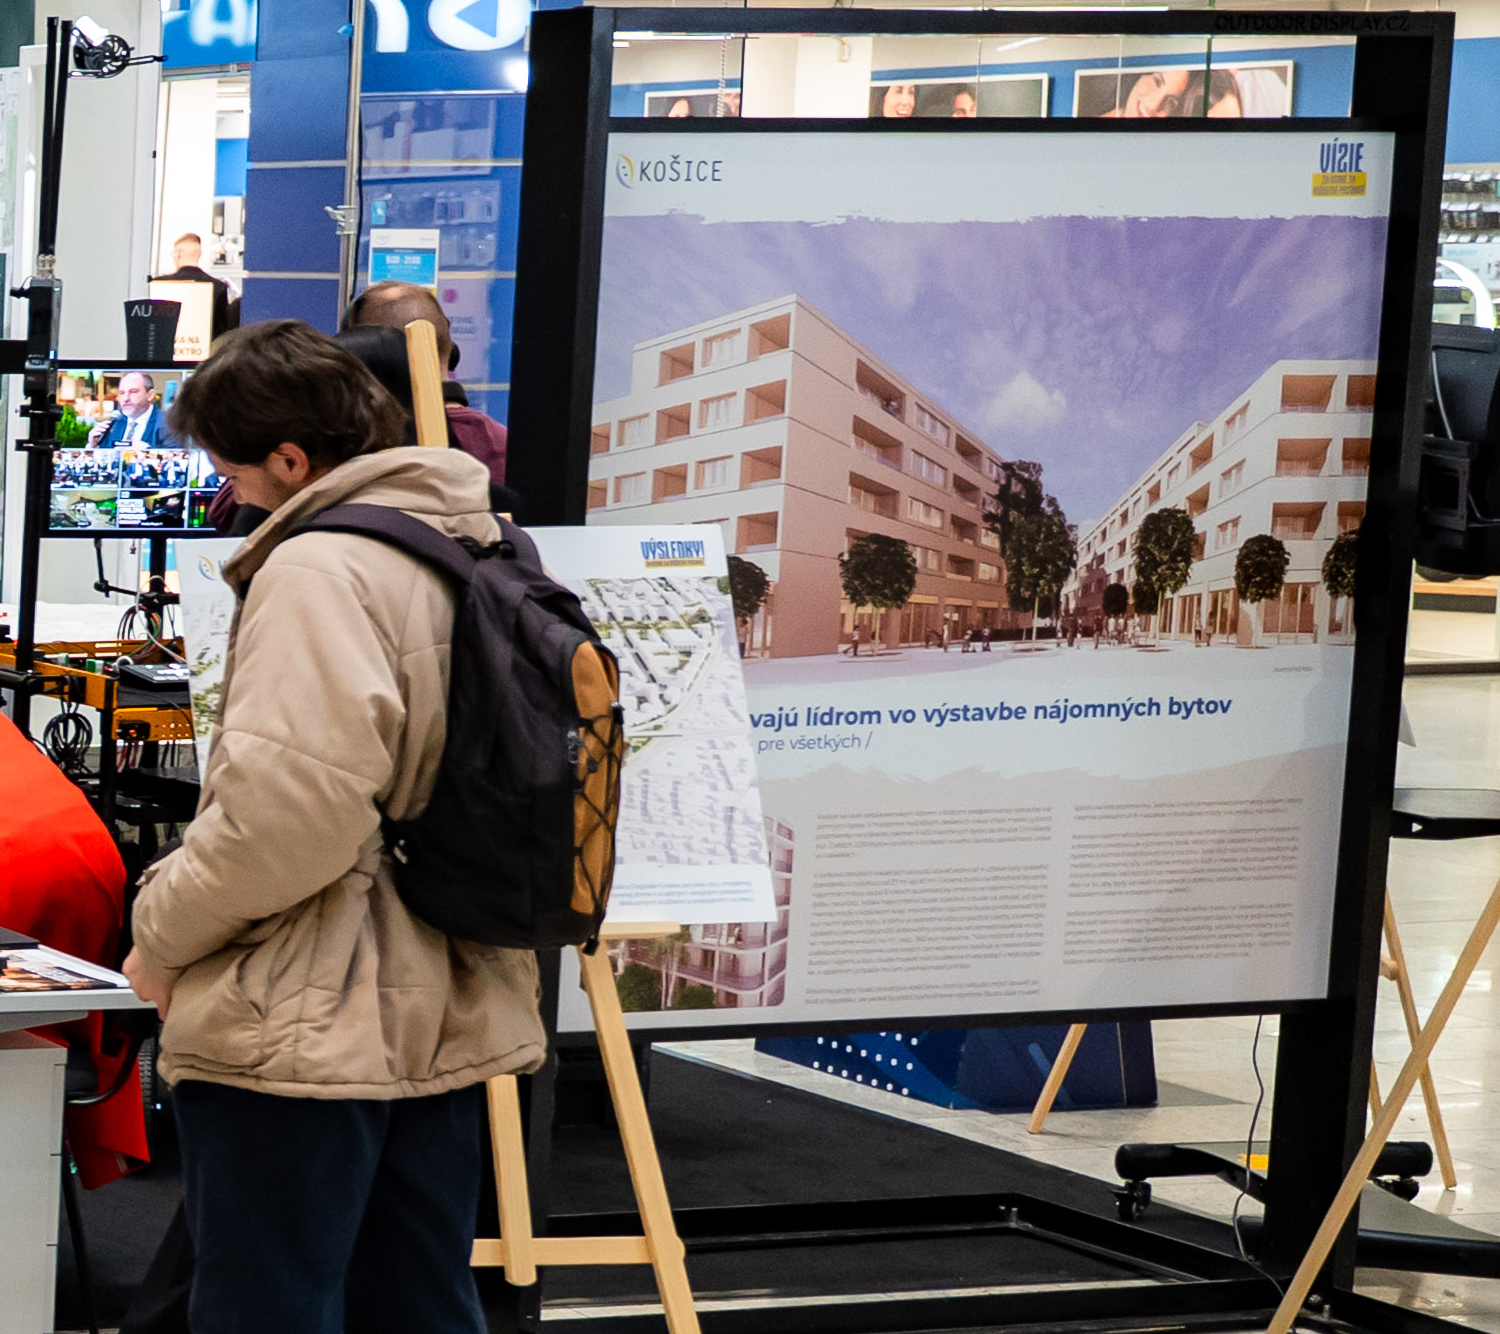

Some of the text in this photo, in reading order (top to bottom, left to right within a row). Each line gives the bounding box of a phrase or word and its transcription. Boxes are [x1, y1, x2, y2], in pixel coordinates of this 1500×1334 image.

[638, 153, 724, 183] KOŠICE
[806, 704, 882, 727] lídrom
[888, 709, 917, 725] vo
[923, 702, 1027, 727] výstavbe
[1033, 698, 1161, 723] nájomných
[1168, 696, 1233, 721] bytov
[757, 737, 785, 754] pre
[789, 732, 862, 752] všetkých
